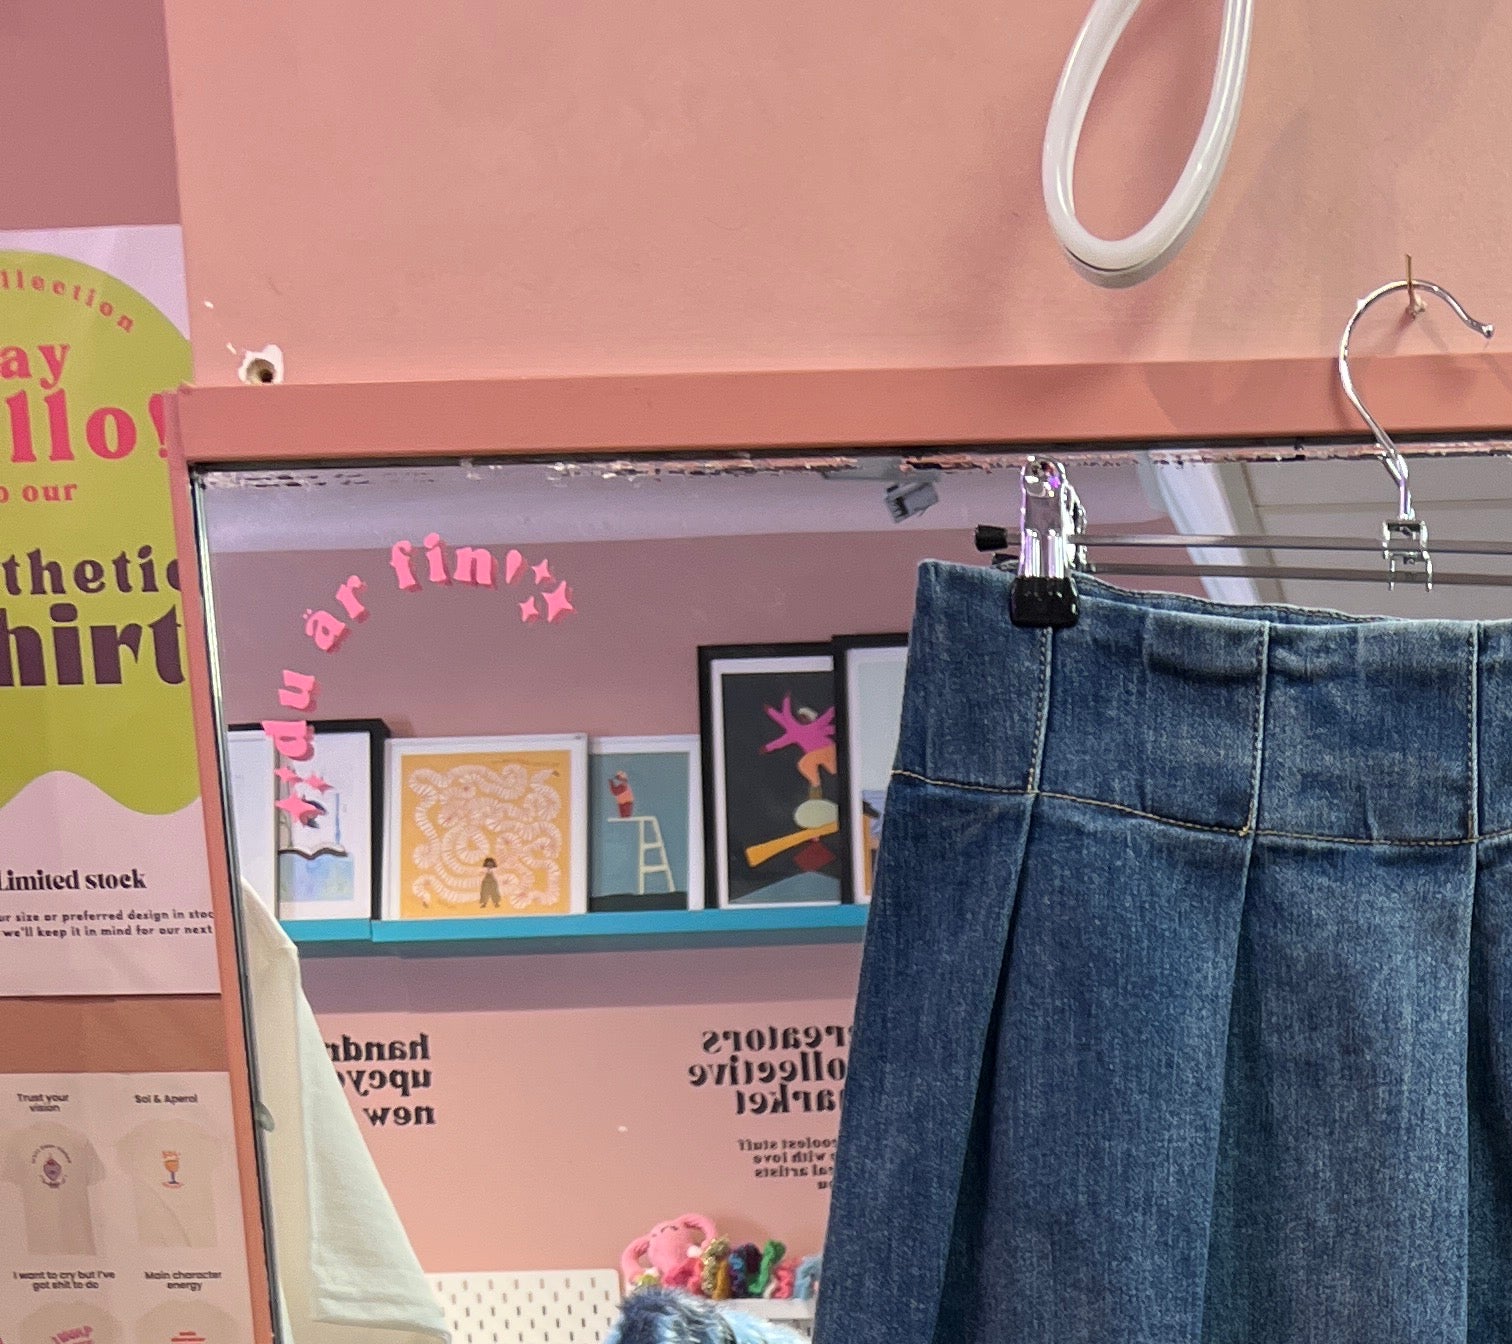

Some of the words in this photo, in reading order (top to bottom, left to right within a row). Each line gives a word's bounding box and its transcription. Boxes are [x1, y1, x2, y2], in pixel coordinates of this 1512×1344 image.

[22, 484, 77, 502] our
[85, 868, 147, 889] stock
[16, 911, 38, 921] size
[62, 910, 123, 924] preferred
[128, 910, 168, 922] design
[172, 908, 185, 919] in
[3, 927, 33, 937] we'll
[37, 926, 67, 939] keep
[71, 926, 80, 936] it
[85, 926, 97, 936] in
[101, 925, 132, 936] mind
[136, 925, 153, 935] for
[159, 927, 180, 935] our
[185, 925, 213, 934] next
[17, 1093, 43, 1102] Trust
[46, 1094, 69, 1104] your
[48, 1271, 57, 1279] to
[78, 1271, 95, 1279] but
[145, 1271, 170, 1279] Main
[173, 1271, 222, 1279] character
[167, 1282, 202, 1291] energy
